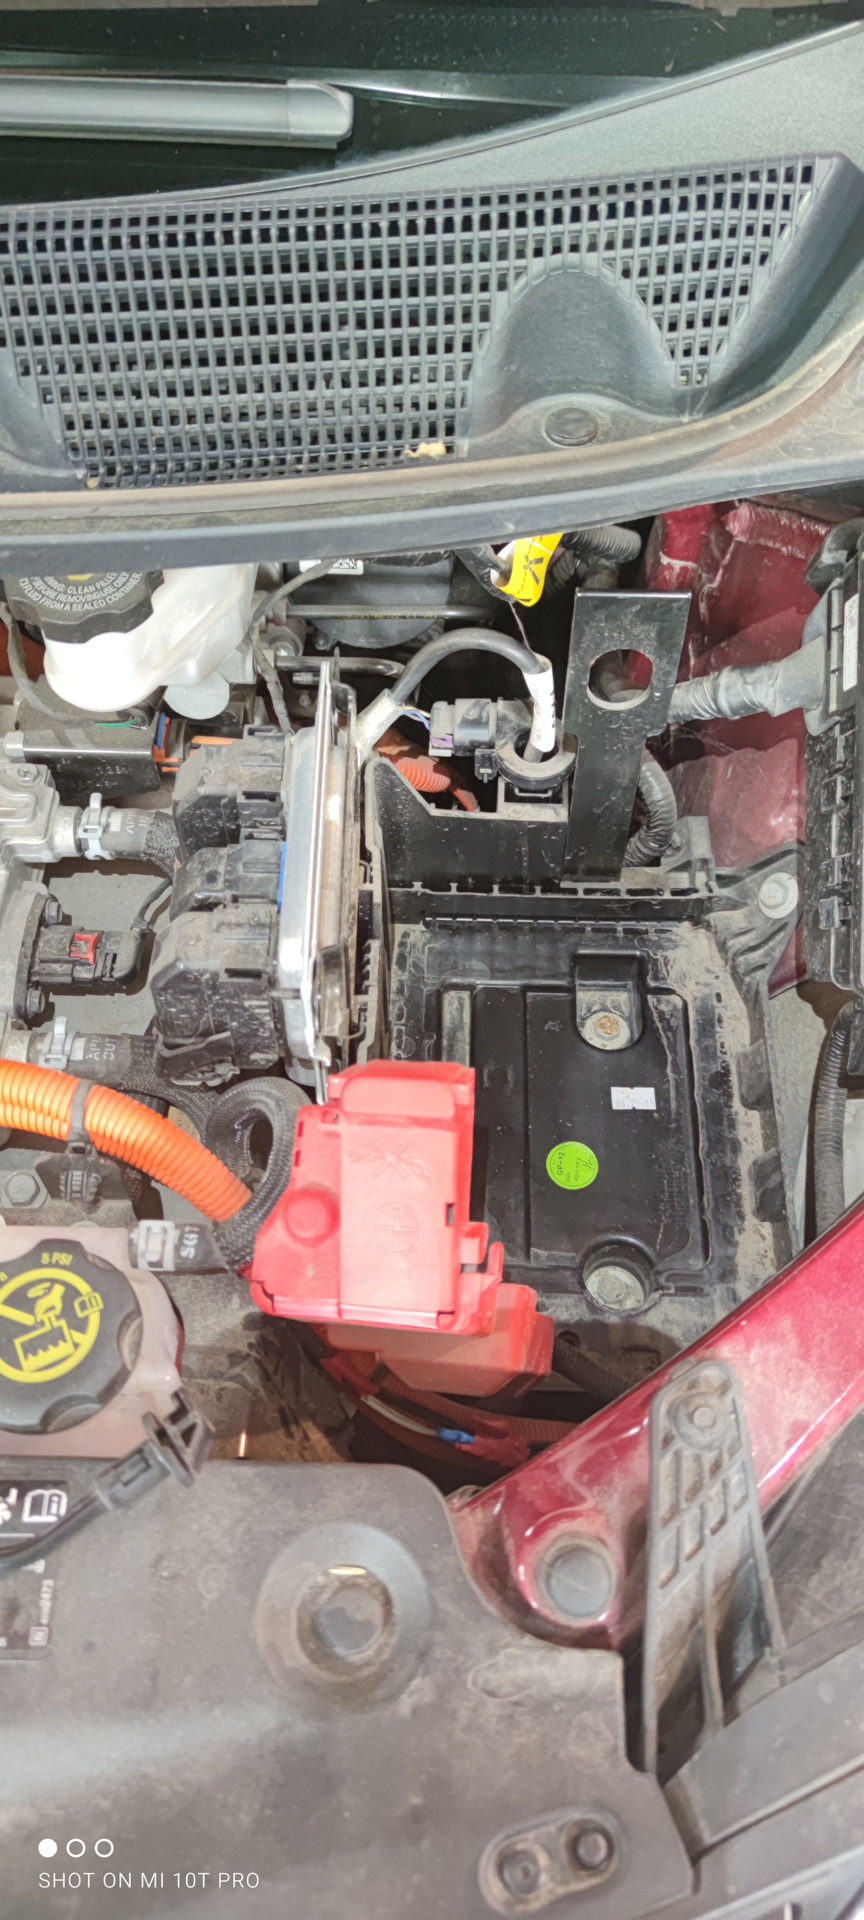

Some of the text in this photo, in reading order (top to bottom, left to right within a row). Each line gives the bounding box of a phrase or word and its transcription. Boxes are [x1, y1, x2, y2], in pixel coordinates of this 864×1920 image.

[32, 579, 59, 599] BEFORE
[100, 584, 117, 597] USE
[113, 571, 130, 588] ONLY
[67, 584, 96, 594] CLEAN
[22, 585, 42, 601] FLUID
[39, 597, 64, 610] FROM
[63, 603, 71, 611] A
[72, 599, 106, 611] SEALED
[557, 1151, 565, 1176] GP-12
[41, 1251, 73, 1266] 5 PSI
